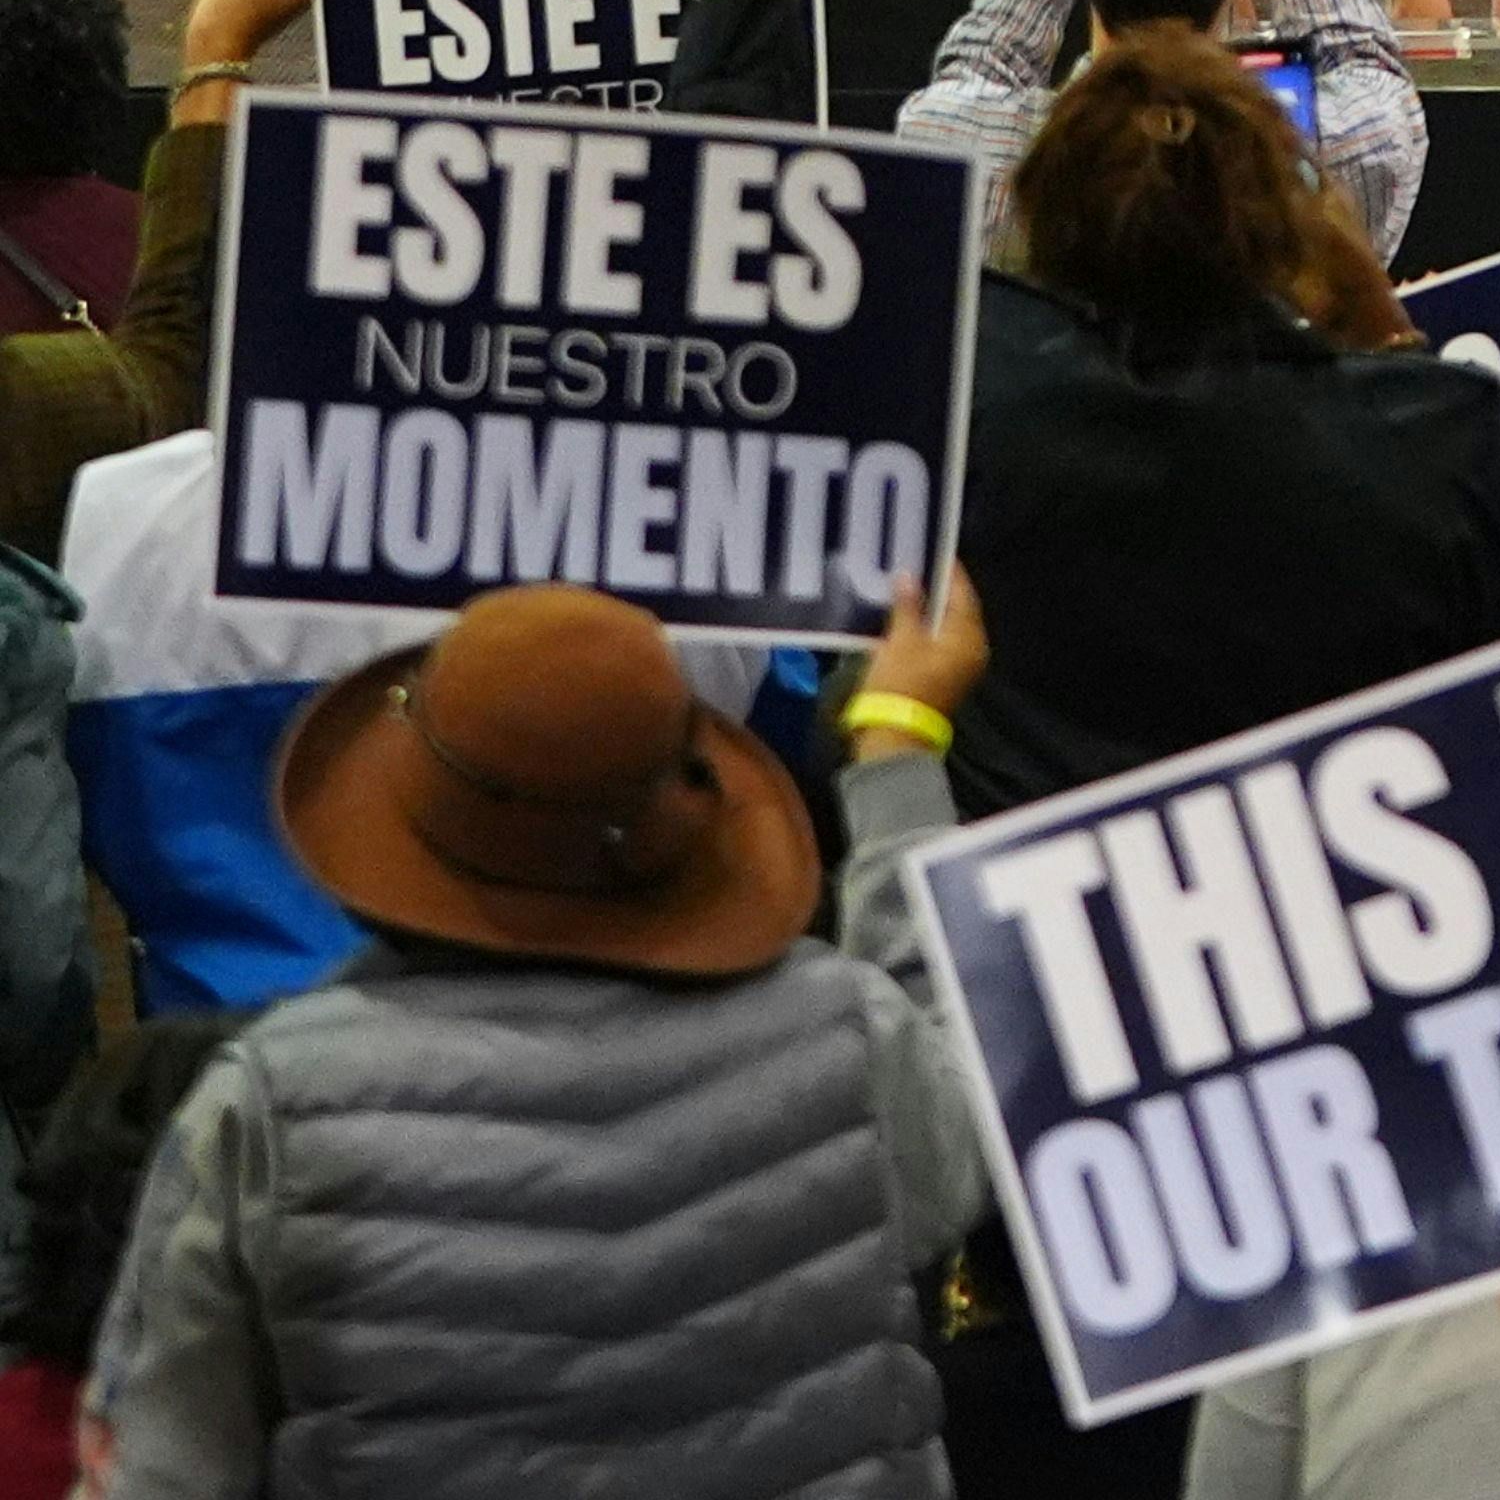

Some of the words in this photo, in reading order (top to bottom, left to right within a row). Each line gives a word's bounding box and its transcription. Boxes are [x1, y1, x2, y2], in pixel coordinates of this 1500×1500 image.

[307, 114, 652, 318] ESTE
[689, 137, 867, 333] ES
[353, 316, 798, 421] NUESTRO
[237, 399, 932, 602] MOMENTO
[979, 725, 1494, 1106] THIS
[1026, 1041, 1418, 1336] OUR
